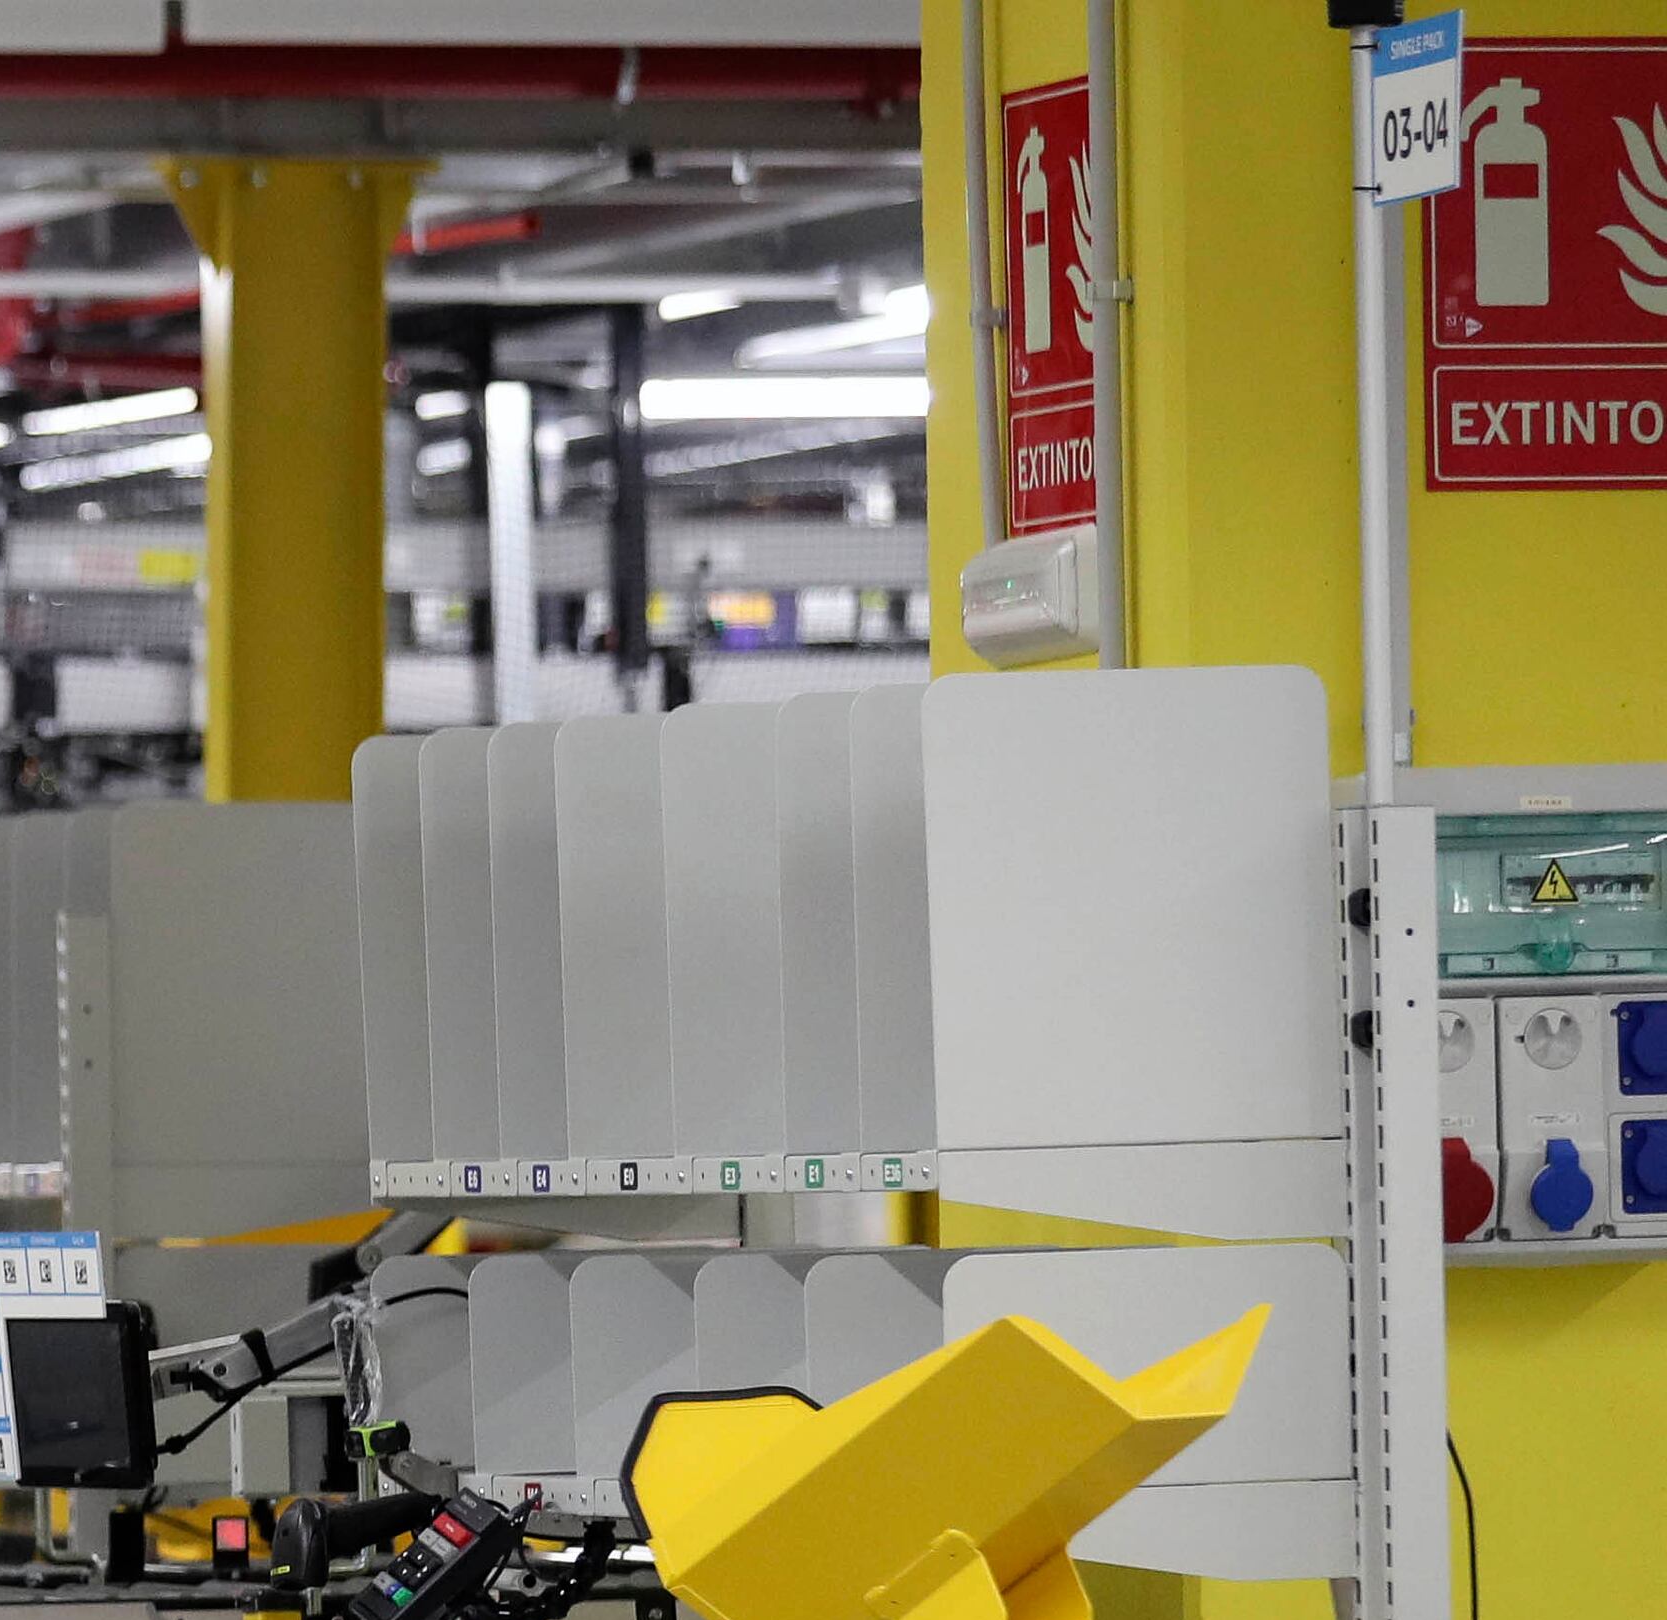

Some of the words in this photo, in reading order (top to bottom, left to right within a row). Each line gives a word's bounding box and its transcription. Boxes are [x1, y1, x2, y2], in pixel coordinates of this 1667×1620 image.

[1390, 36, 1422, 60] SINGLE
[1423, 31, 1444, 52] PACK
[1383, 98, 1448, 161] 03-04
[1451, 400, 1665, 445] EXTINTO
[1018, 436, 1093, 491] EXTINTO
[467, 1170, 478, 1188] E6
[536, 1170, 547, 1188] E4
